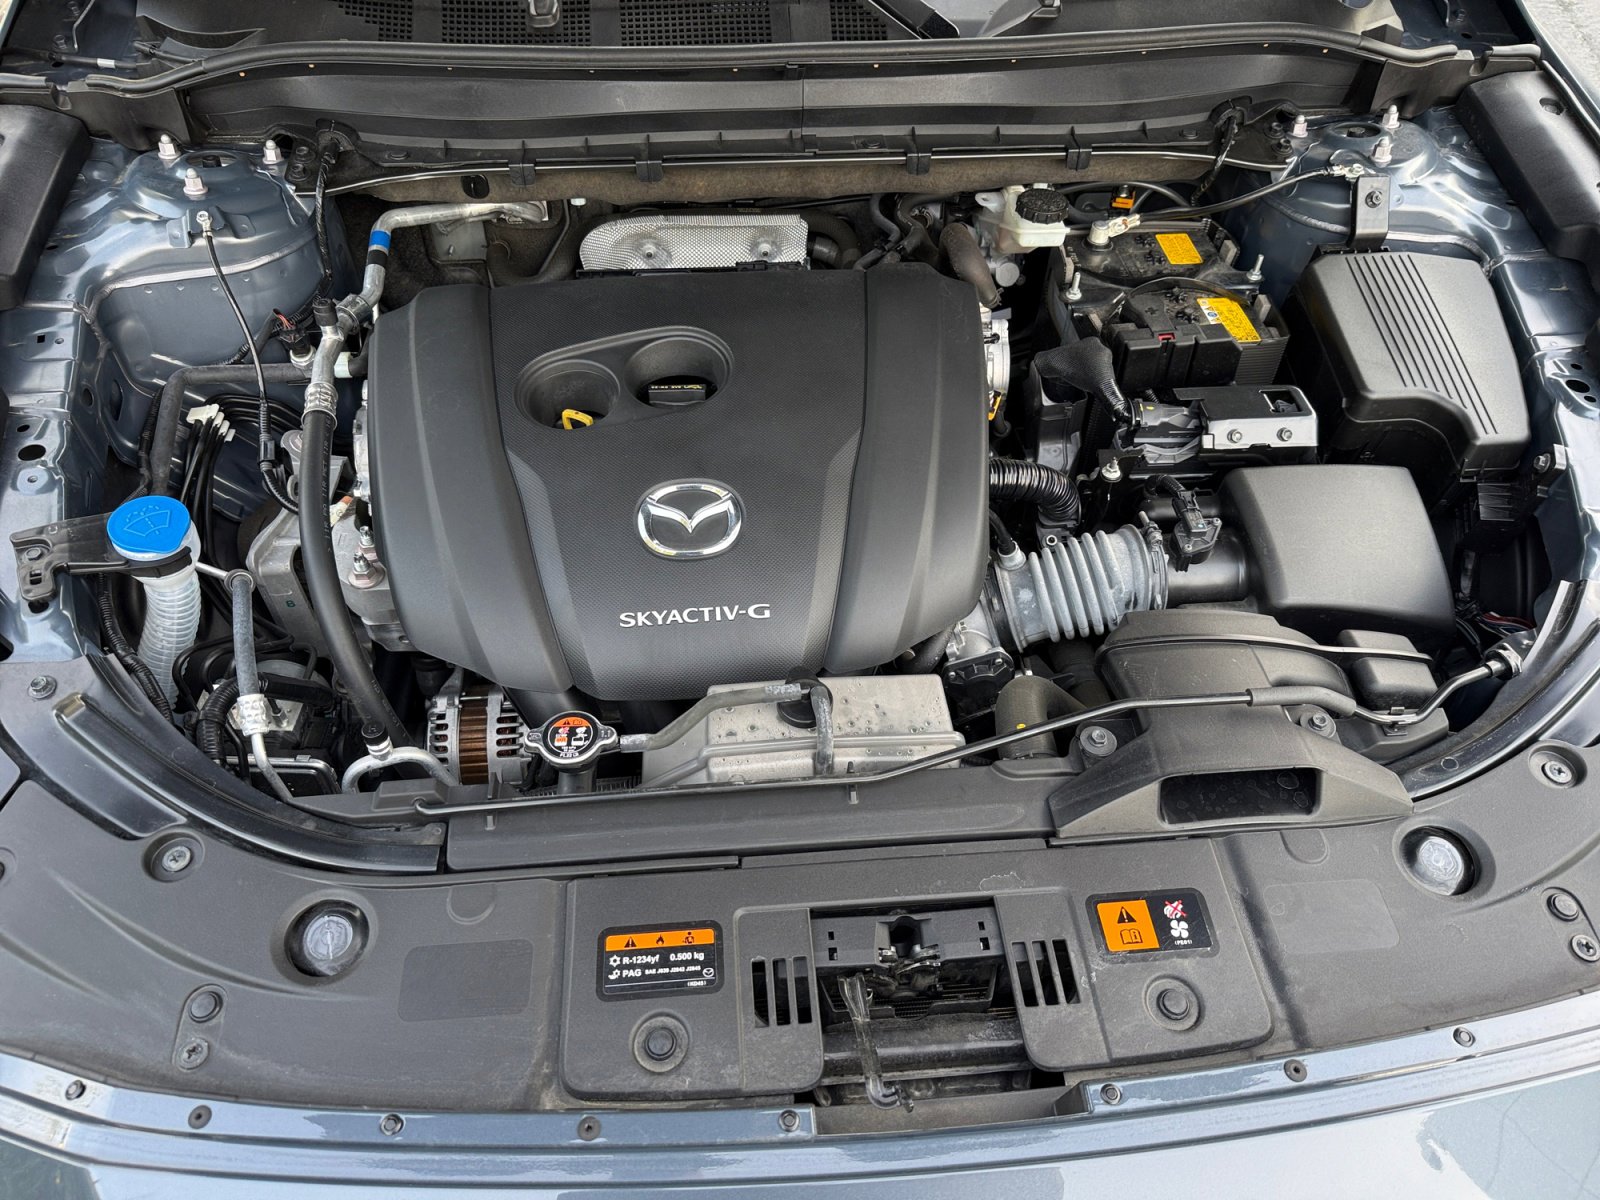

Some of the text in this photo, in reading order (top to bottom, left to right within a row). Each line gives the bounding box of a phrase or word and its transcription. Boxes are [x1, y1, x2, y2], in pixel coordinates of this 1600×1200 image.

[619, 603, 771, 628] SKYACTIV-G
[622, 951, 705, 965] R-1234yf 0.500 kg
[622, 969, 642, 978] PAG
